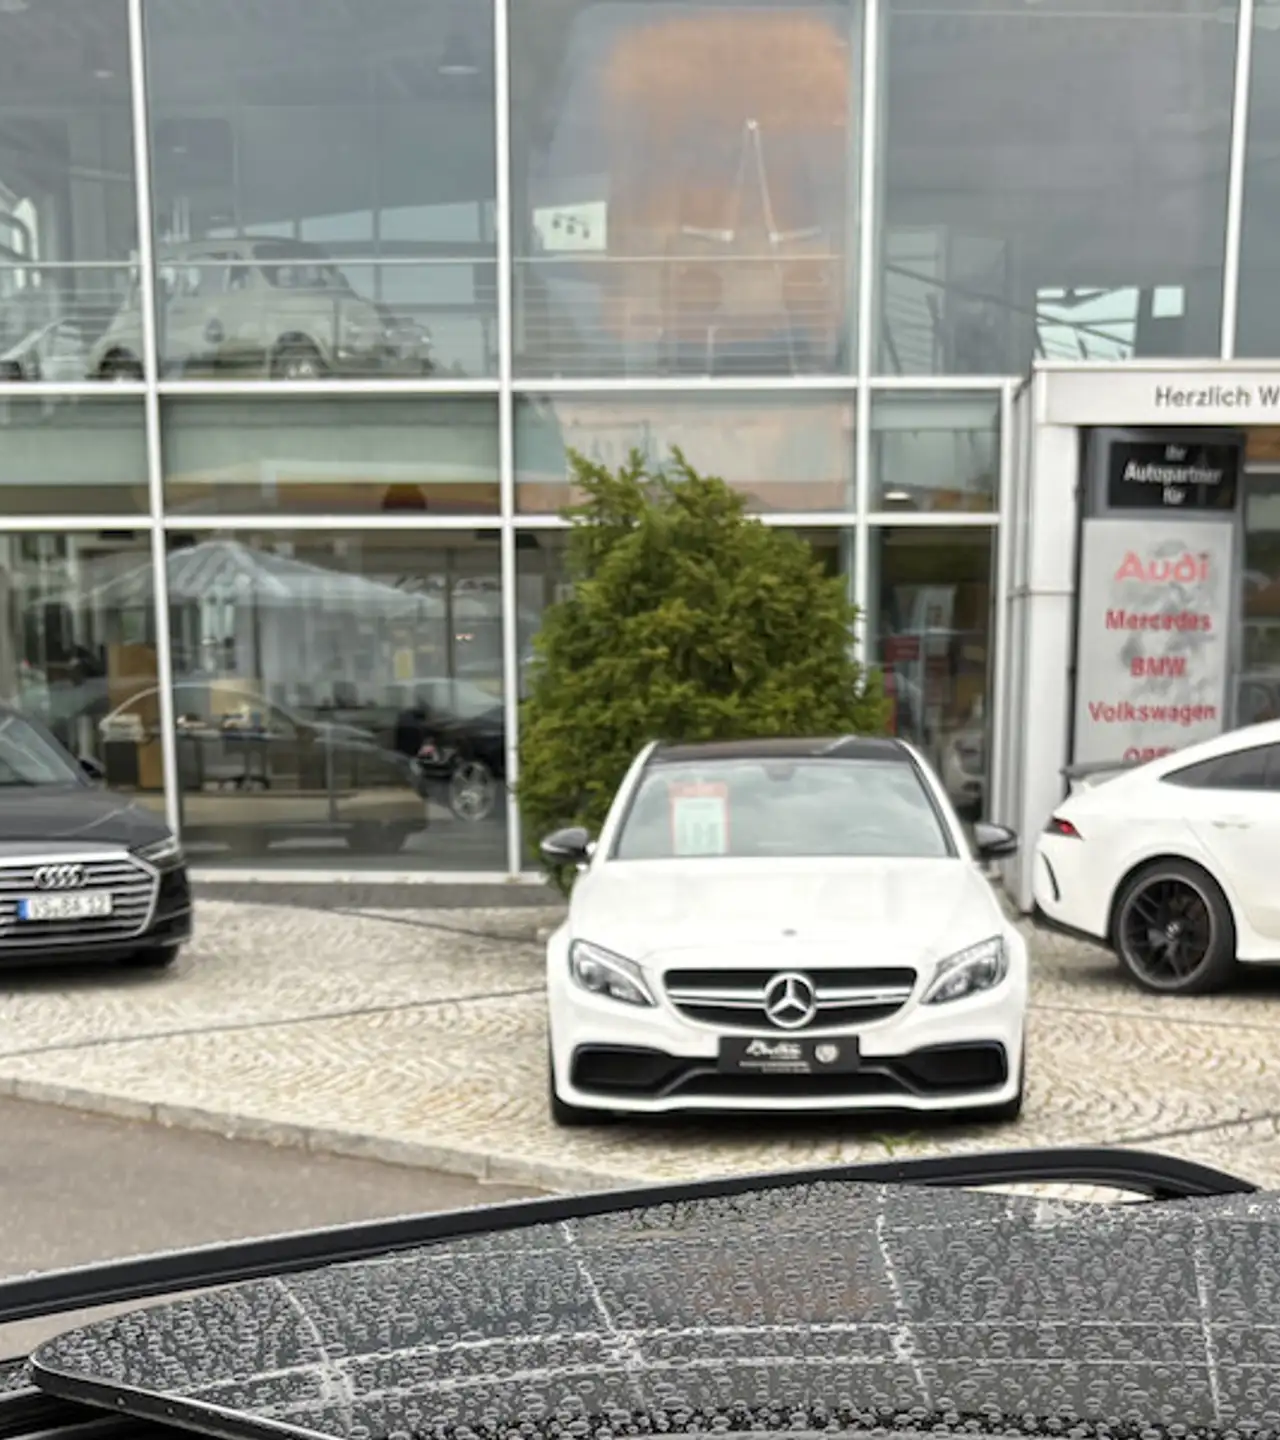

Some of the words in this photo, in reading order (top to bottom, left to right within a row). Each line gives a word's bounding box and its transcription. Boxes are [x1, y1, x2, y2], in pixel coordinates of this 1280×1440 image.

[1154, 385, 1251, 408] Herzlich
[1123, 460, 1222, 485] Autopartner
[1114, 550, 1211, 583] Audi
[1105, 608, 1212, 631] Mercedes
[1130, 655, 1188, 678] BMW
[1087, 700, 1218, 728] Volkswagen
